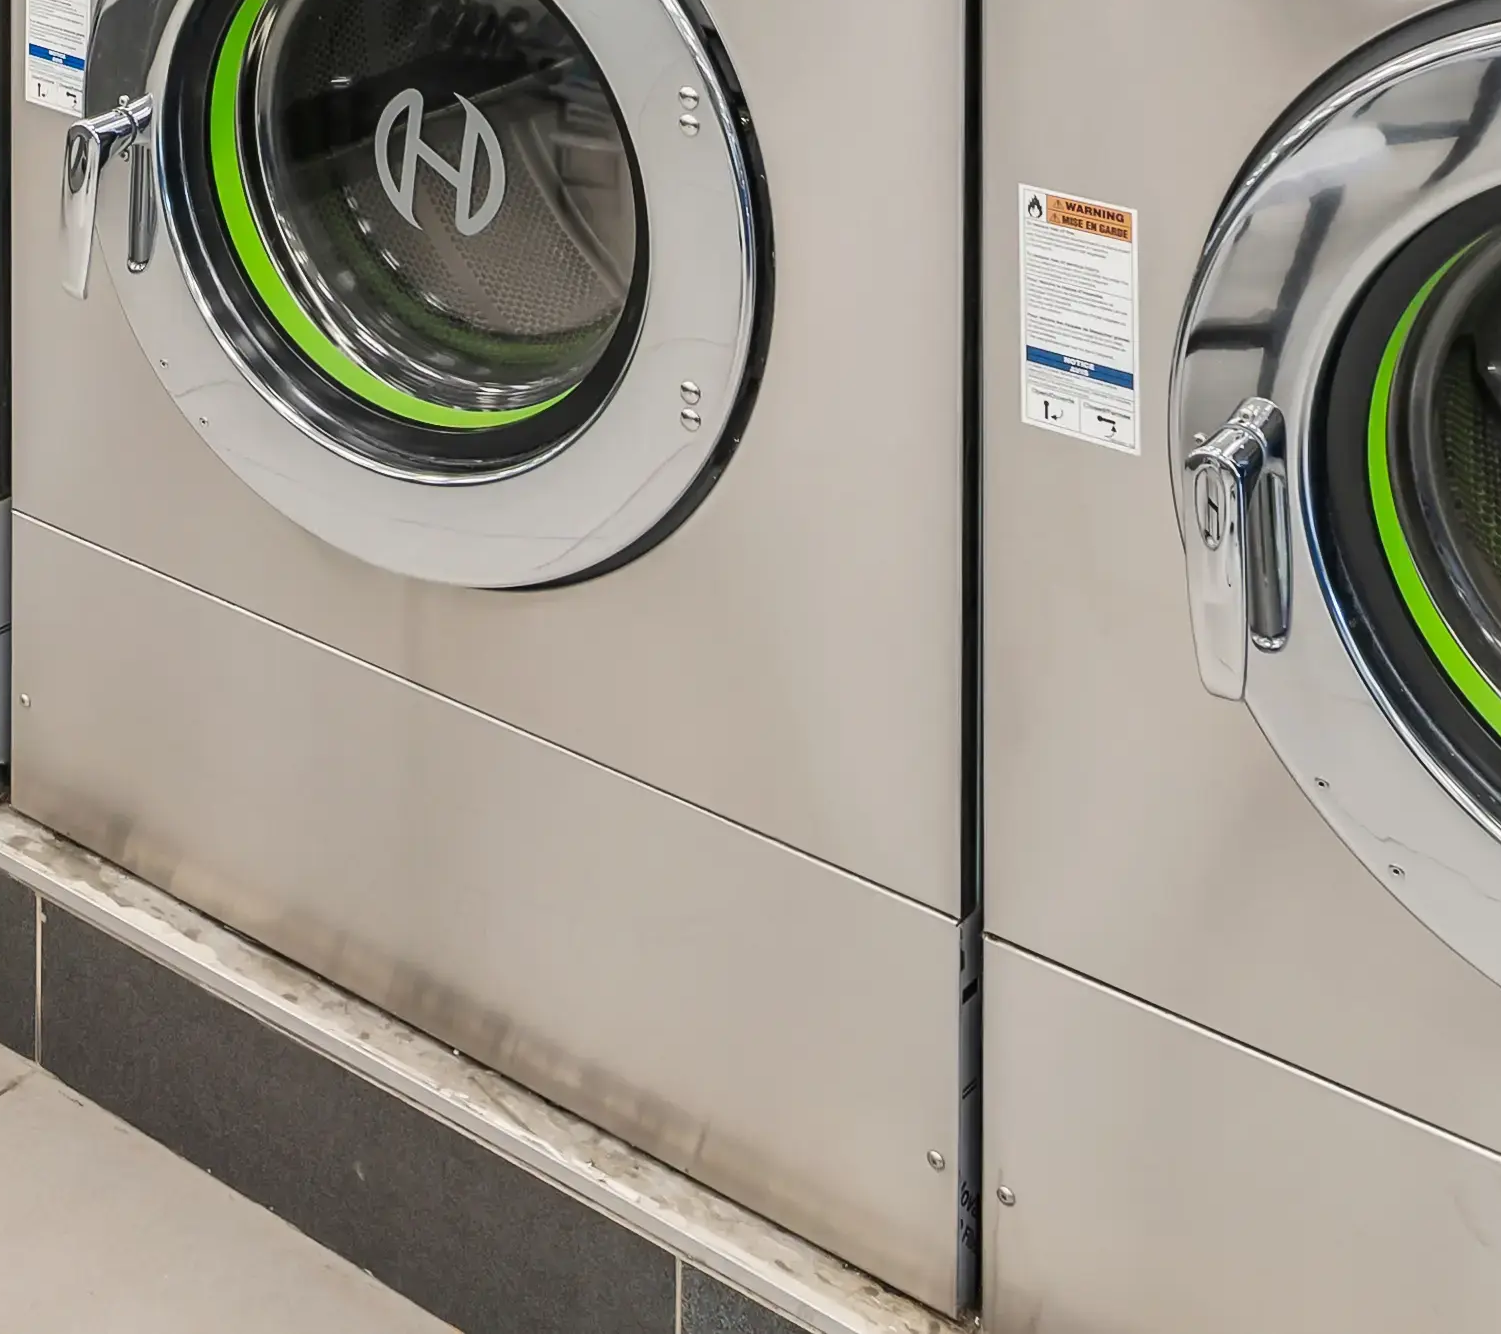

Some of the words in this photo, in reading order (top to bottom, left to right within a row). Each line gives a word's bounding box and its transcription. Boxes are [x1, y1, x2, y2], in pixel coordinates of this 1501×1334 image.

[1065, 201, 1125, 223] WARNING
[1062, 215, 1083, 229] MISE
[1085, 220, 1097, 232] EN
[1099, 224, 1129, 239] GARDE
